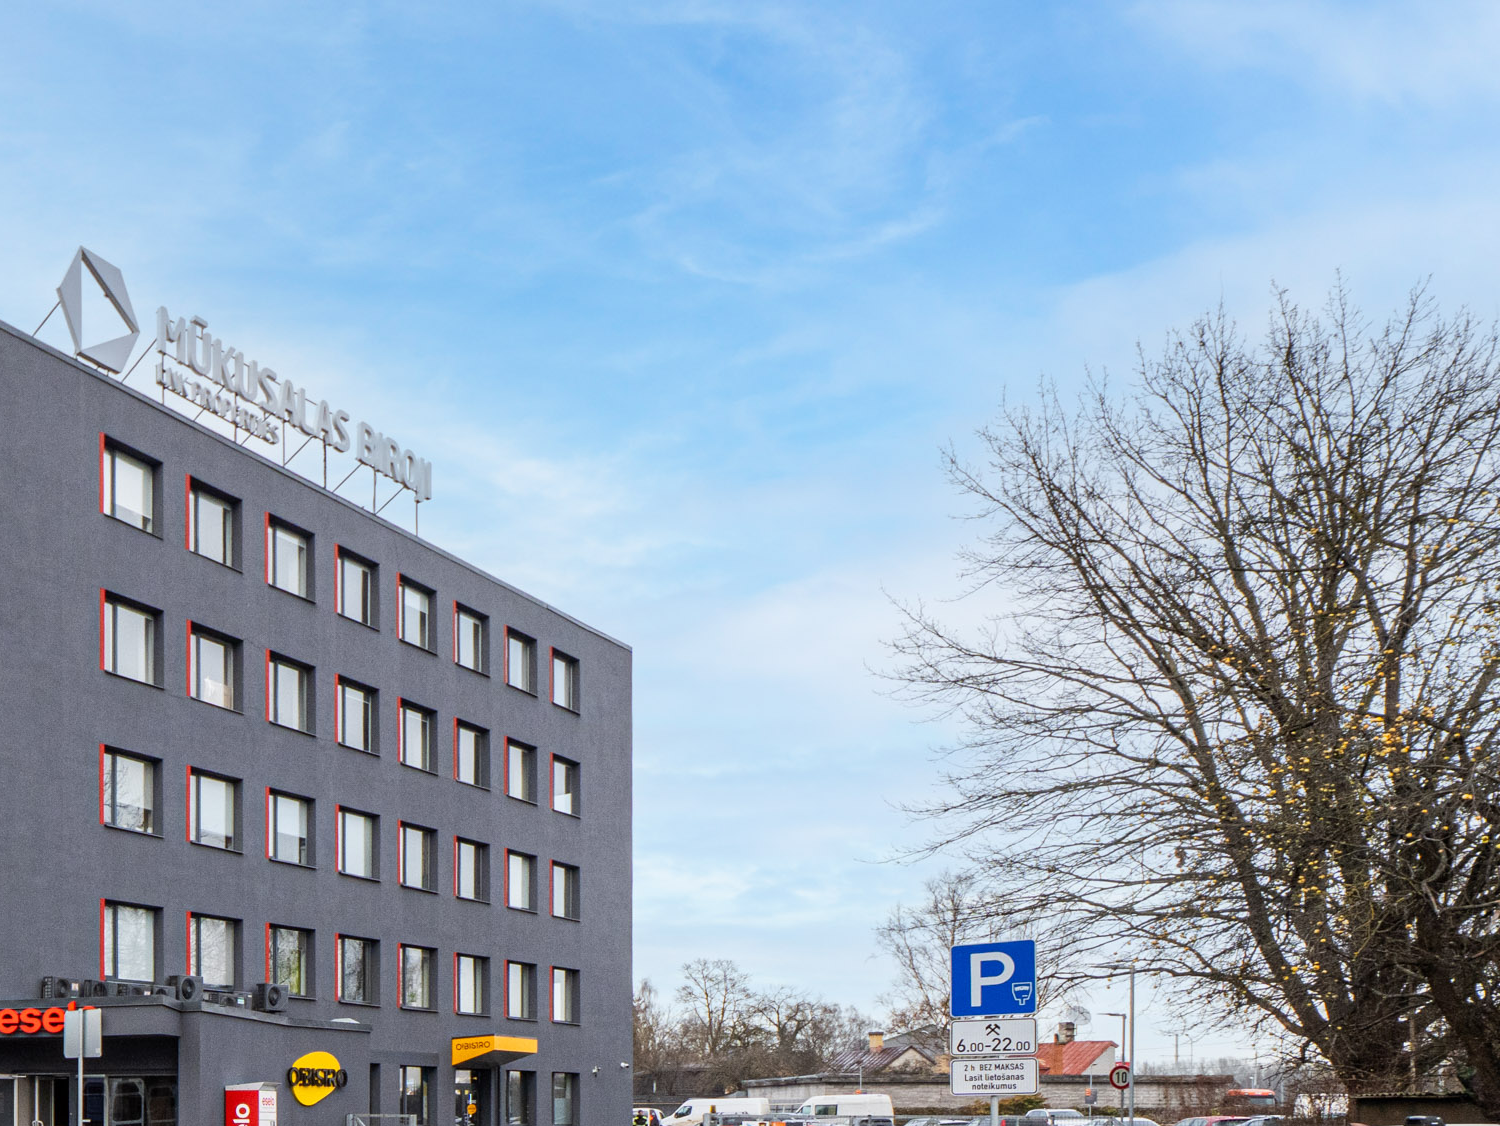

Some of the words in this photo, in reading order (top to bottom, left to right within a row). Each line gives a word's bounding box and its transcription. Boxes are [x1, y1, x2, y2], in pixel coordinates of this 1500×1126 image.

[156, 306, 350, 453] MŪKUSALAS
[970, 951, 1015, 1008] P
[979, 1063, 992, 1071] BEZ
[994, 1062, 1024, 1071] MAKSAS
[985, 1073, 1025, 1081] lietošanas
[1115, 1071, 1128, 1084] 10
[971, 1082, 1017, 1090] noteikumus
